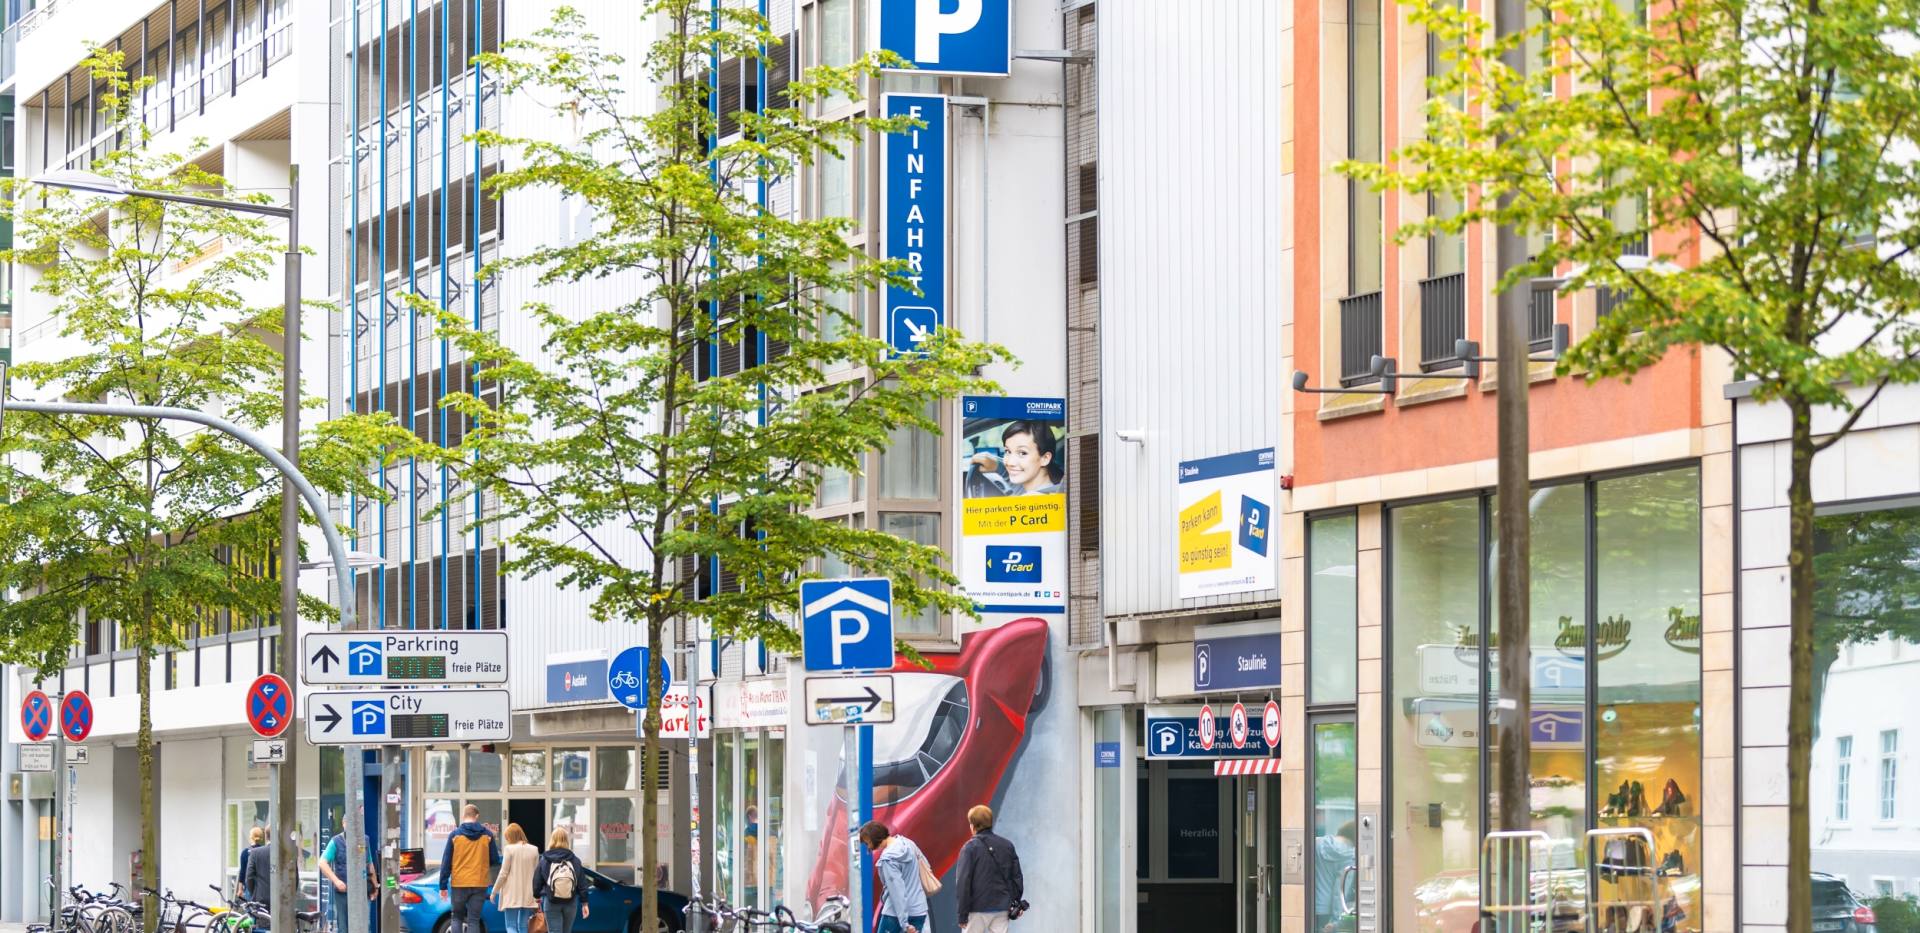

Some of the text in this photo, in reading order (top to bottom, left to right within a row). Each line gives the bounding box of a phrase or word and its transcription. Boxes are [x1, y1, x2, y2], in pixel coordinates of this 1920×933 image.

[914, 0, 983, 64] P
[906, 105, 925, 297] EINFAHRT
[984, 505, 1012, 514] parken
[1028, 503, 1061, 512] günstig.
[978, 514, 1048, 528] Mit der P Card
[1181, 505, 1218, 533] Parken kann
[1182, 551, 1190, 563] so
[1190, 545, 1213, 565] günstig
[386, 636, 459, 655] Parkring
[830, 609, 870, 666] P
[358, 652, 374, 674] P
[388, 656, 444, 678] 306
[452, 661, 502, 673] freie Plätze
[1237, 653, 1267, 672] Staulinie
[390, 694, 423, 714] City
[362, 711, 378, 733] P
[431, 715, 446, 736] 7
[454, 718, 504, 730] freie Plätze
[1202, 718, 1212, 737] 10
[1188, 728, 1224, 738] Zung
[1180, 829, 1218, 838] Herzlich
